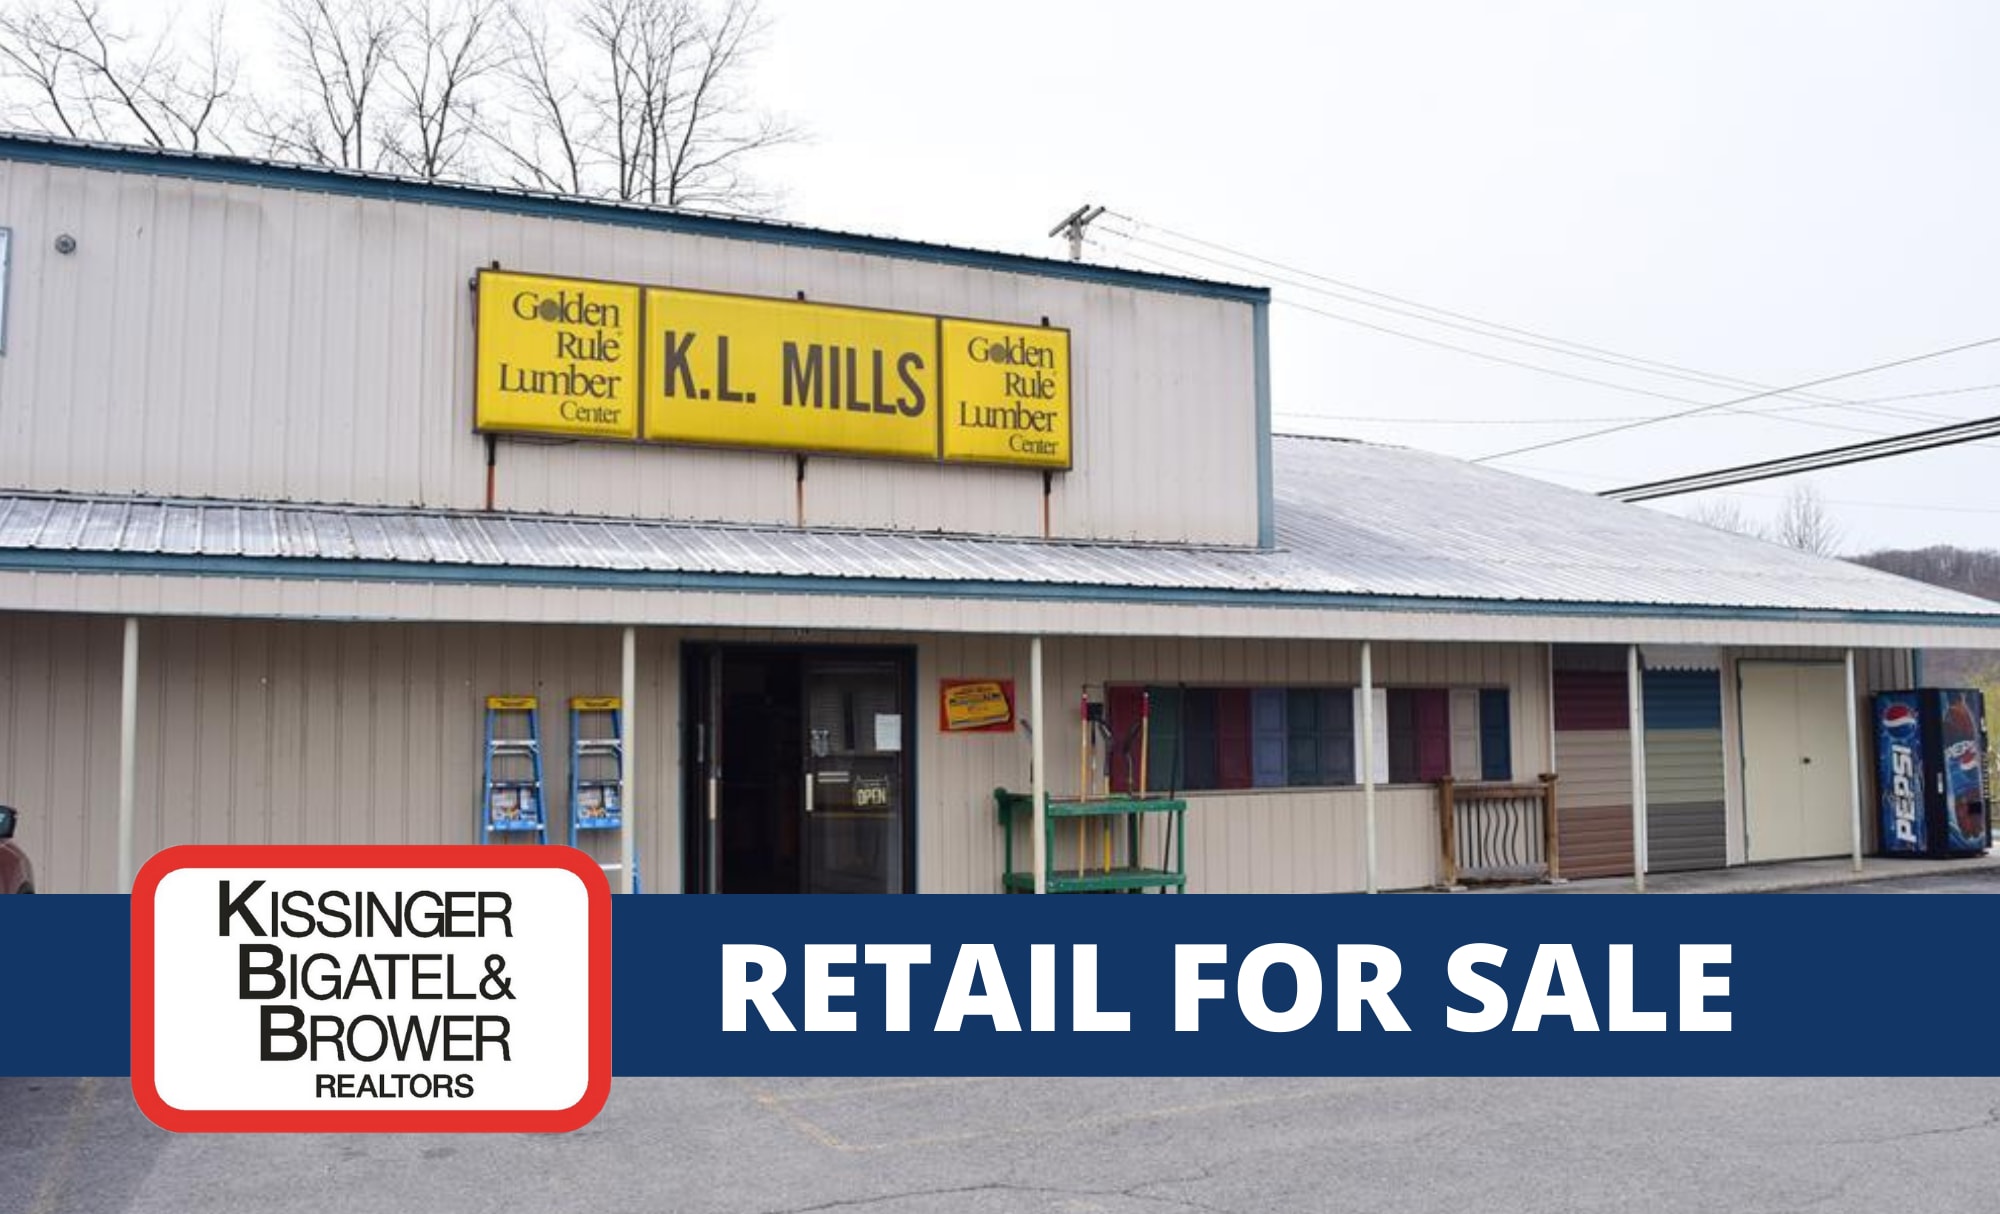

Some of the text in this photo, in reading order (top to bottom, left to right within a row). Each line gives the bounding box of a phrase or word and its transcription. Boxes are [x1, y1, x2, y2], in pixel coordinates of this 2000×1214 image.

[513, 291, 620, 328] Golden
[557, 330, 619, 362] Rule
[967, 335, 1054, 369] Golden
[499, 363, 621, 399] Lumber
[663, 330, 926, 418] K.L. MILLS
[1005, 371, 1056, 400] Rule
[560, 401, 621, 424] Center
[959, 400, 1057, 433] Lumber
[1008, 434, 1058, 456] Center
[857, 787, 886, 806] OPEN
[1892, 745, 1917, 843] PEPSI
